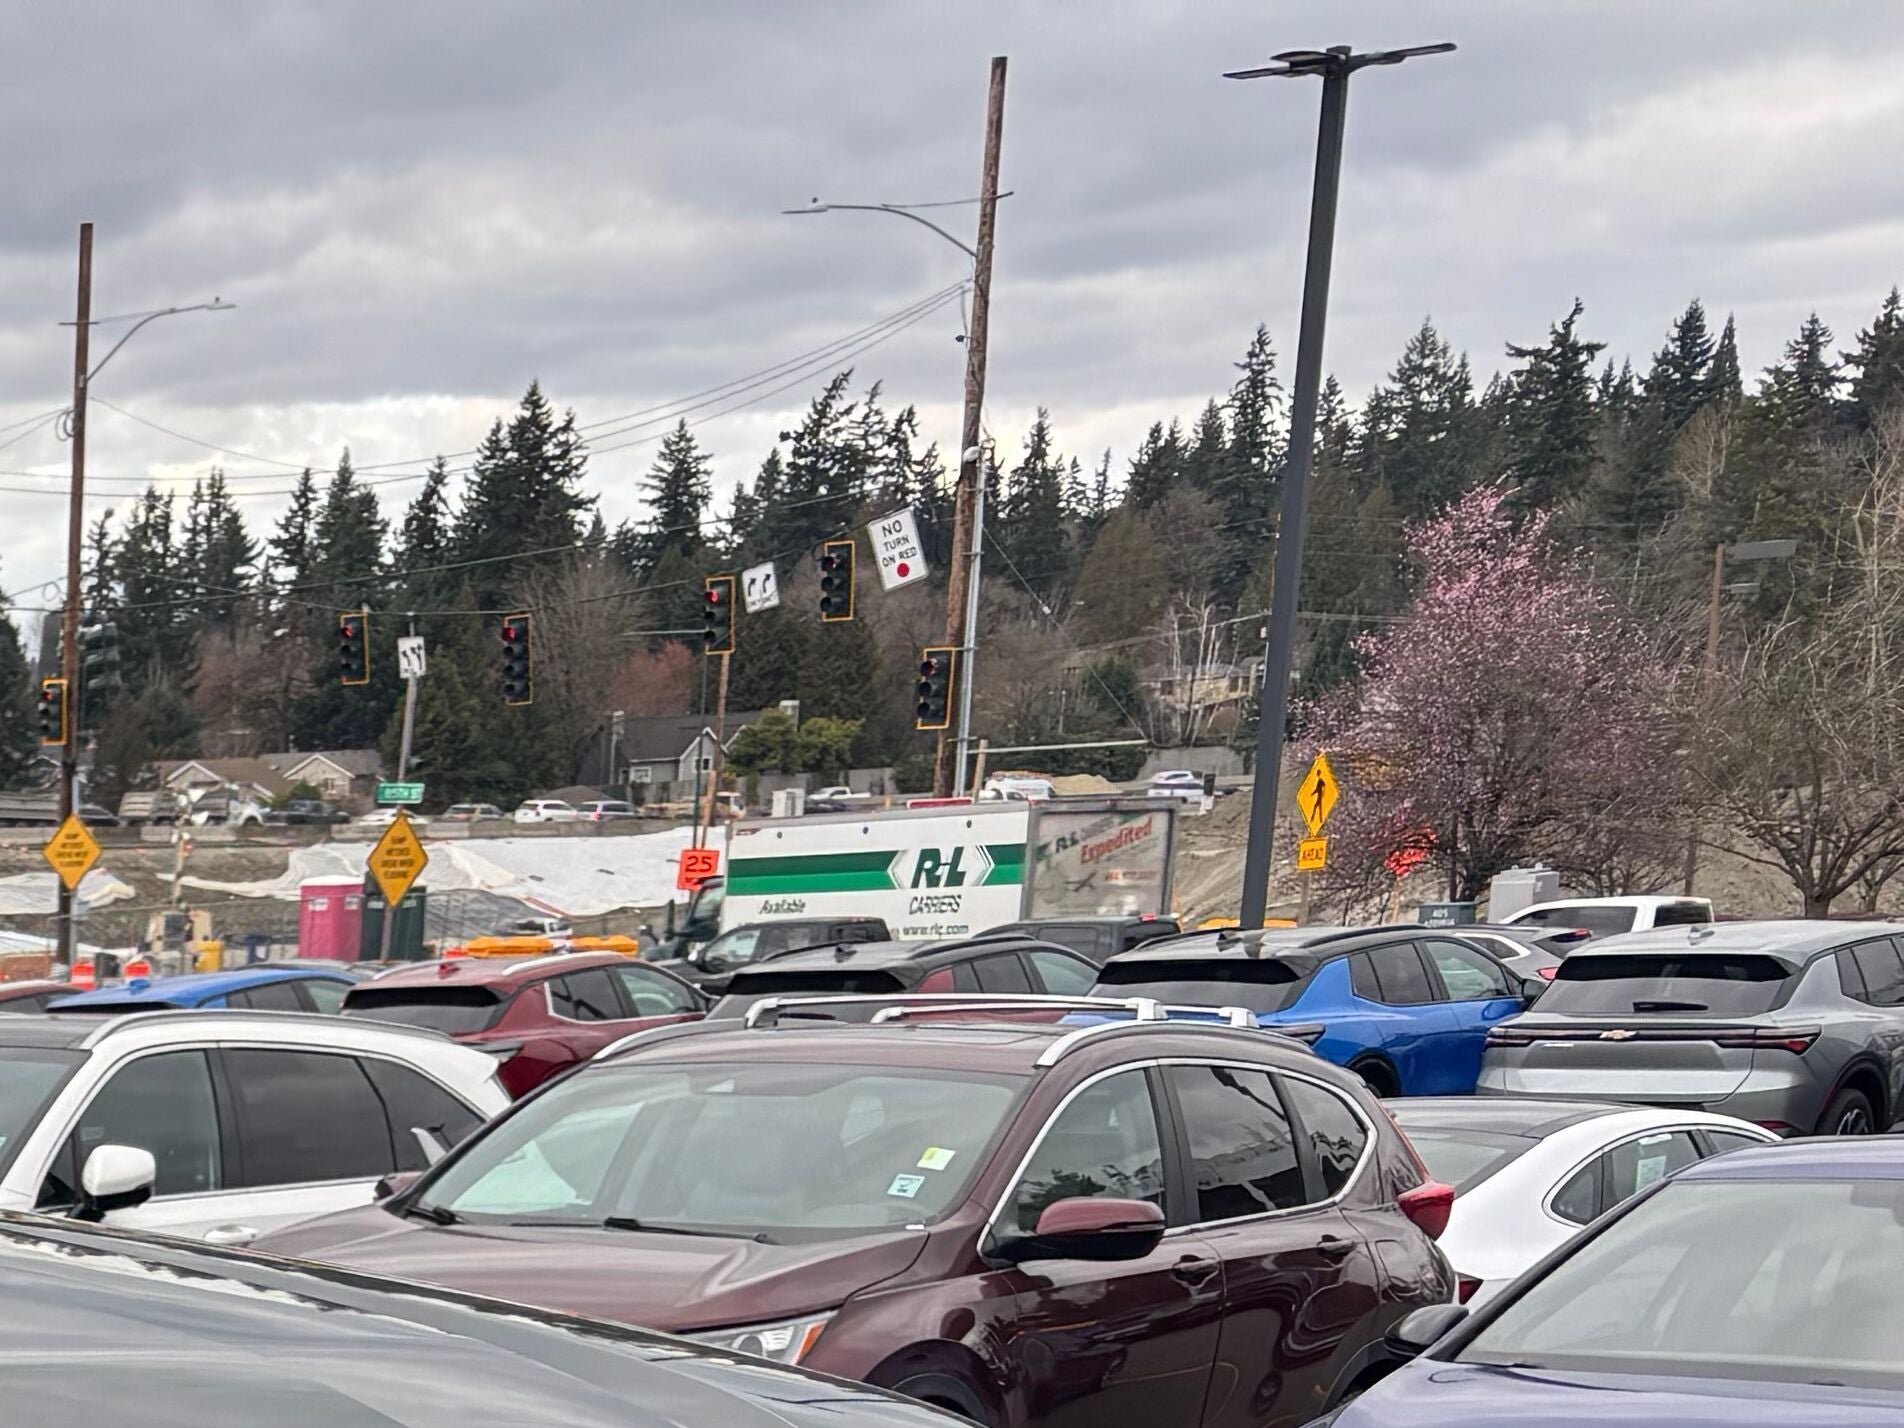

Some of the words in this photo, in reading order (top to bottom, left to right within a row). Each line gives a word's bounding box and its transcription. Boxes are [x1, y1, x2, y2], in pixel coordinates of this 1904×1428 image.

[882, 519, 903, 537] NO
[883, 534, 910, 552] TURN
[882, 555, 896, 568] ON
[898, 546, 918, 562] RED
[1079, 816, 1153, 864] Expedited
[685, 855, 712, 873] 25
